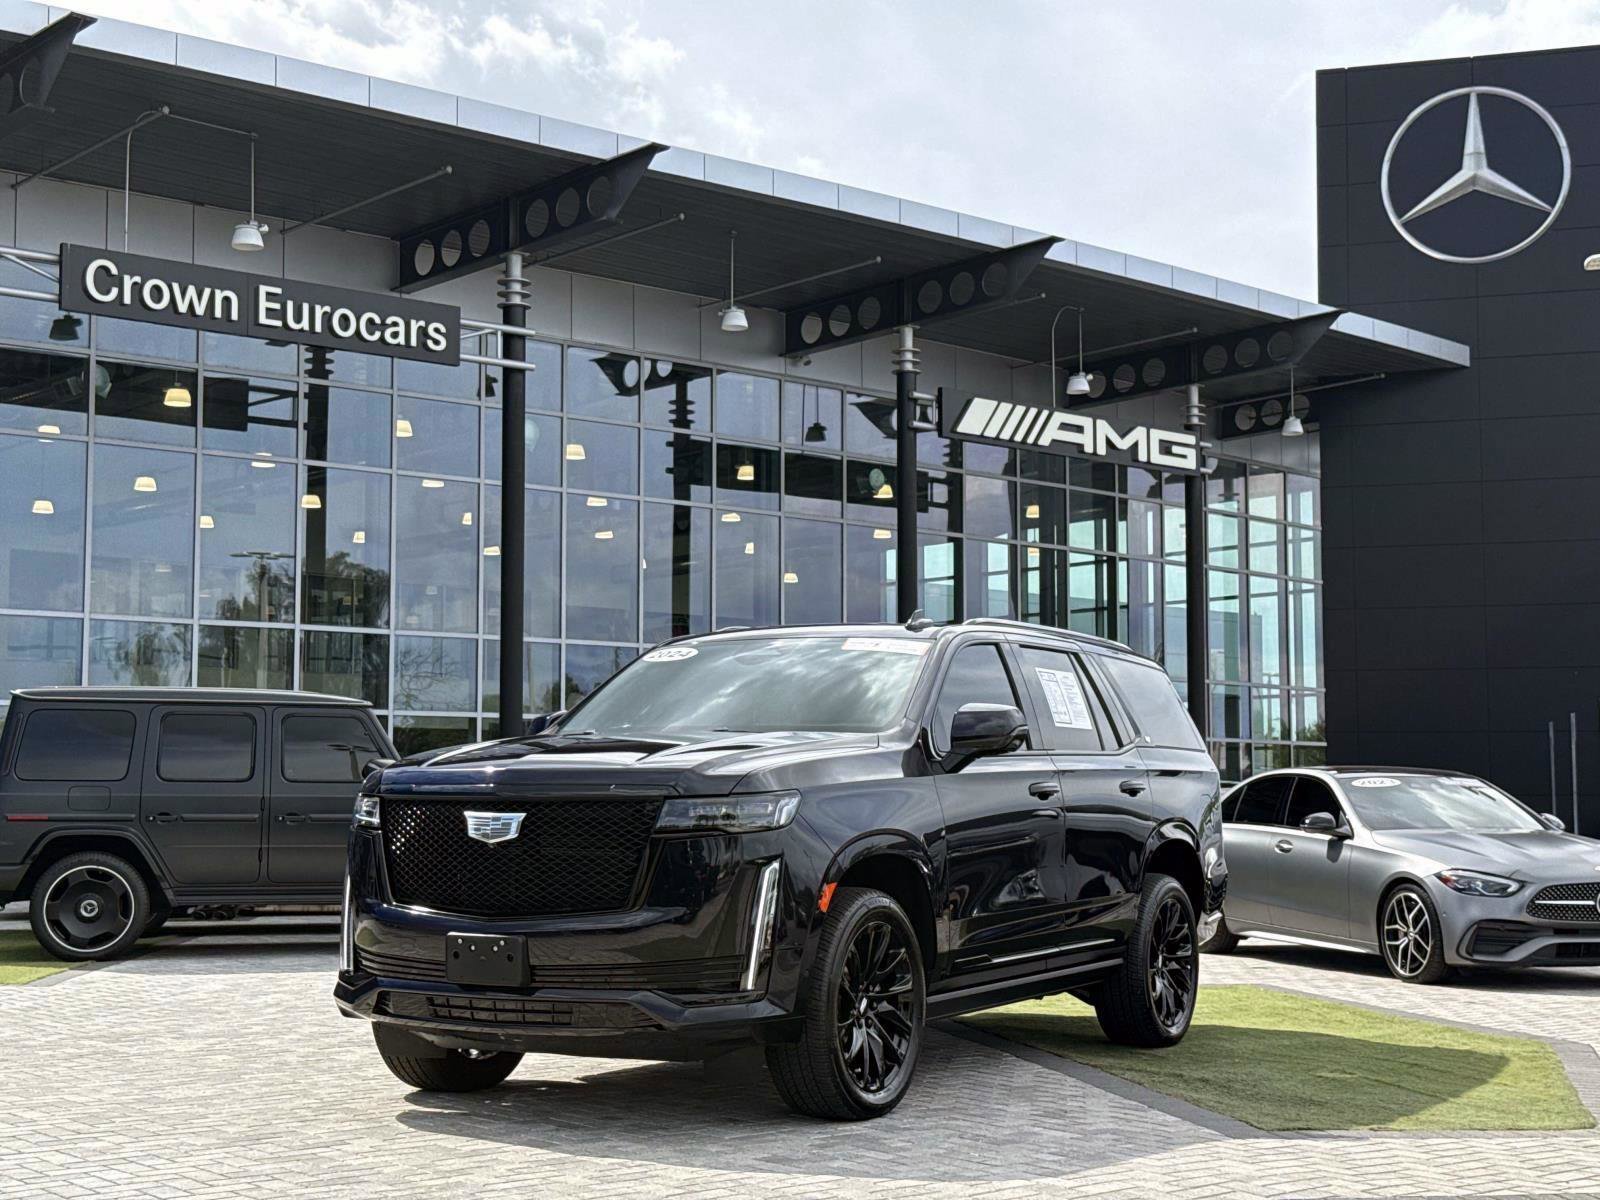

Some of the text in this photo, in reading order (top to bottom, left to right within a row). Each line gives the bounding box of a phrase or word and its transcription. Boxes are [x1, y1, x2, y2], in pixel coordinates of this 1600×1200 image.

[85, 258, 448, 352] Crown Eurocars
[1037, 411, 1197, 470] AMG
